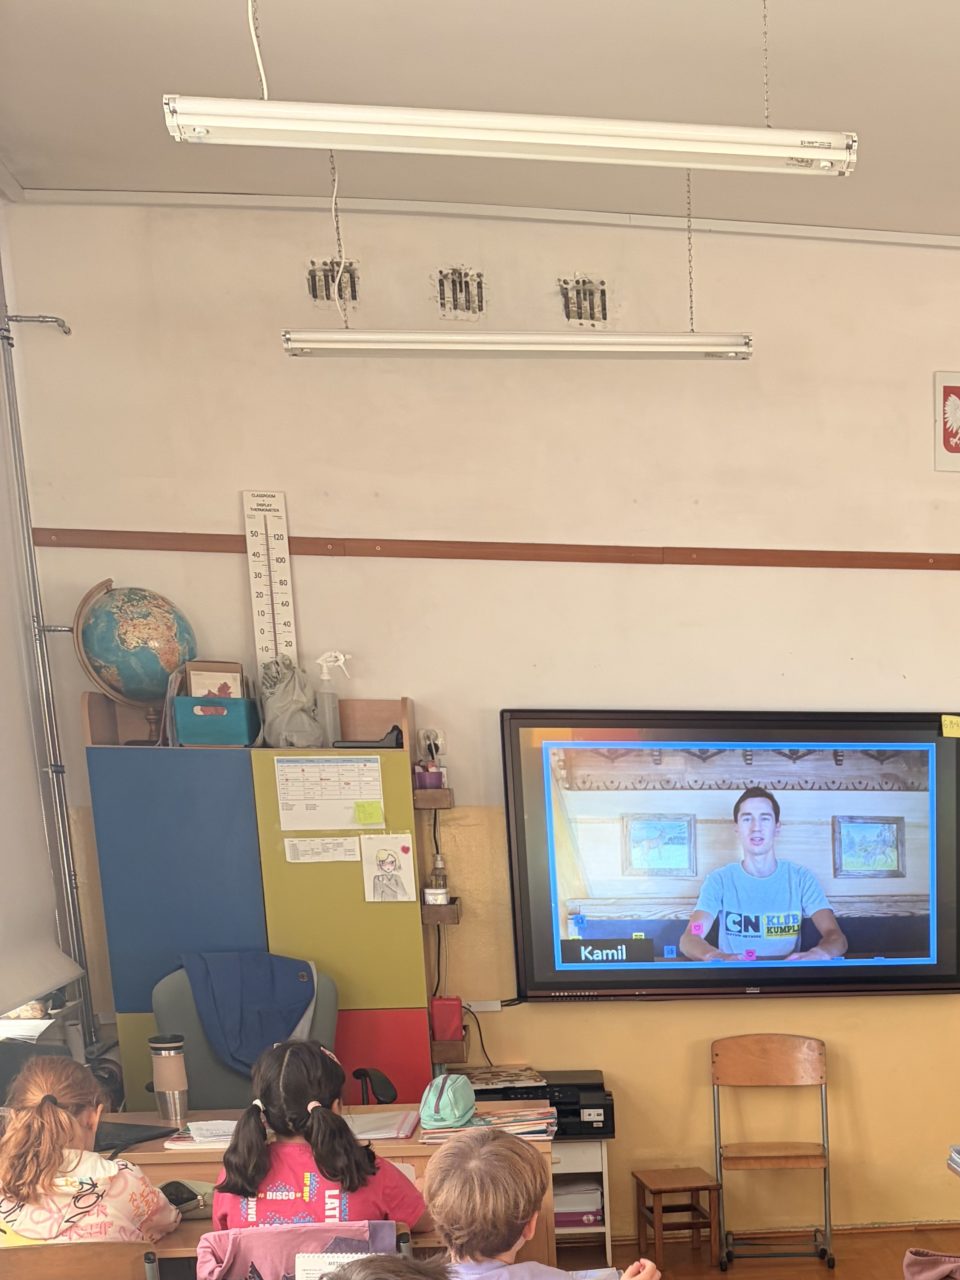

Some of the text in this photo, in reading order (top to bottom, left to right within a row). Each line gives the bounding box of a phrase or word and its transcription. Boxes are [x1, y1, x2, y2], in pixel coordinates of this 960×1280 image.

[581, 944, 626, 960] Kamil
[266, 1192, 295, 1200] DISCO
[325, 1190, 339, 1222] LATI
